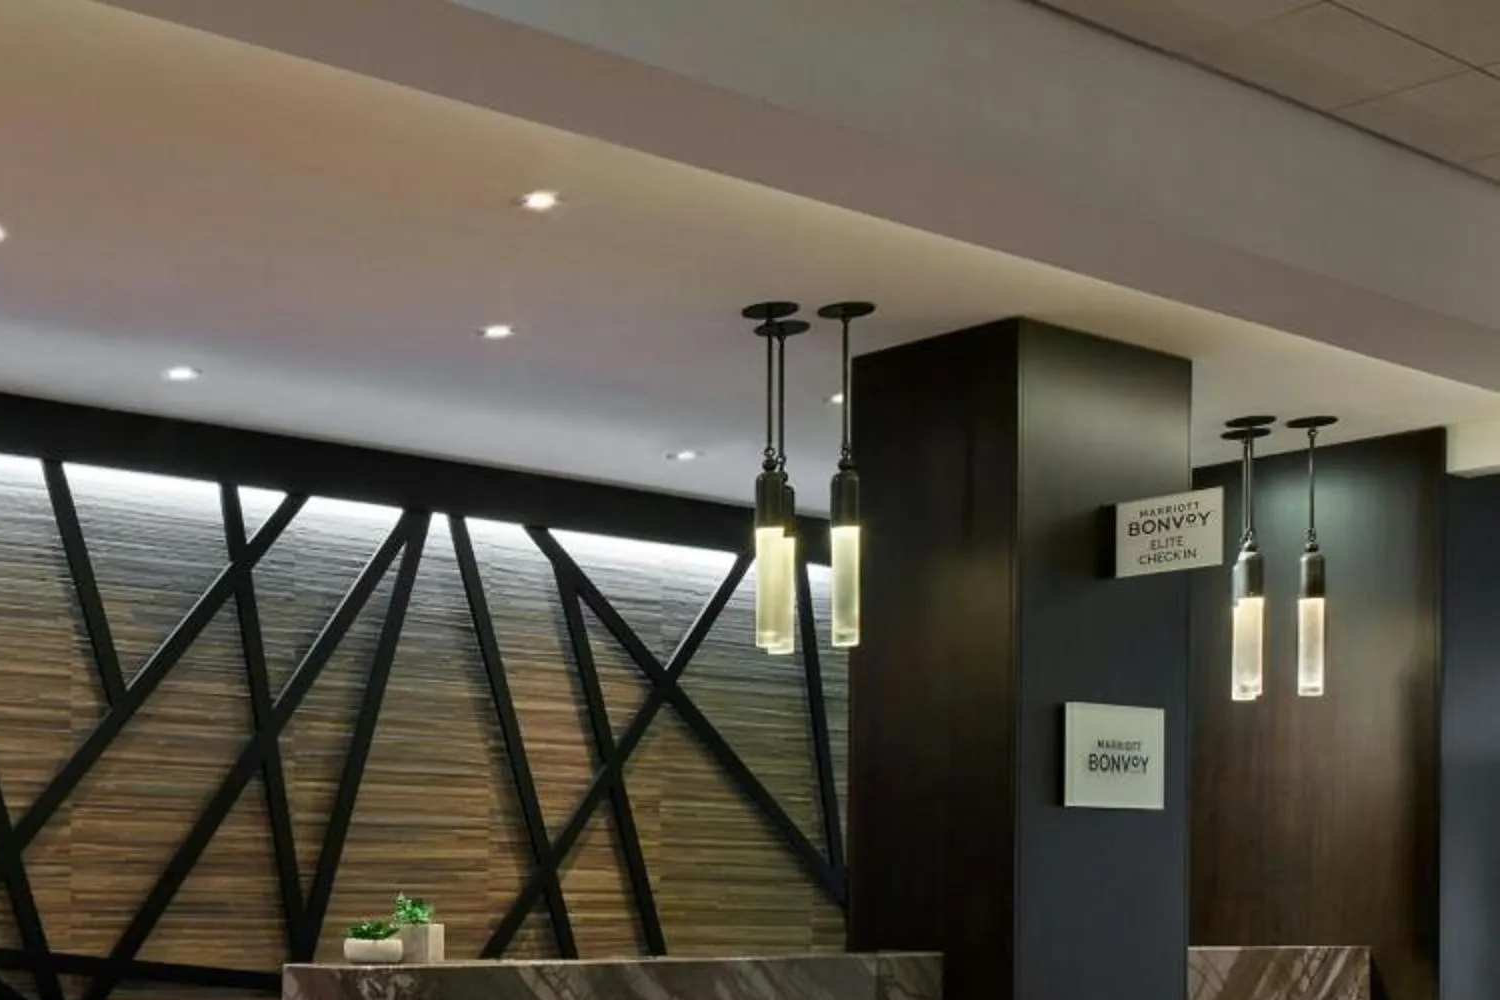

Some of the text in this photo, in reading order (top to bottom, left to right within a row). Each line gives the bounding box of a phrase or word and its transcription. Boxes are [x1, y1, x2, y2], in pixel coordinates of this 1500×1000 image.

[1139, 501, 1199, 518] MARRIOTT
[1128, 511, 1211, 537] BONVOY
[1150, 536, 1185, 550] ELITE
[1139, 551, 1181, 565] CHECK
[1088, 753, 1149, 775] BONVOY
